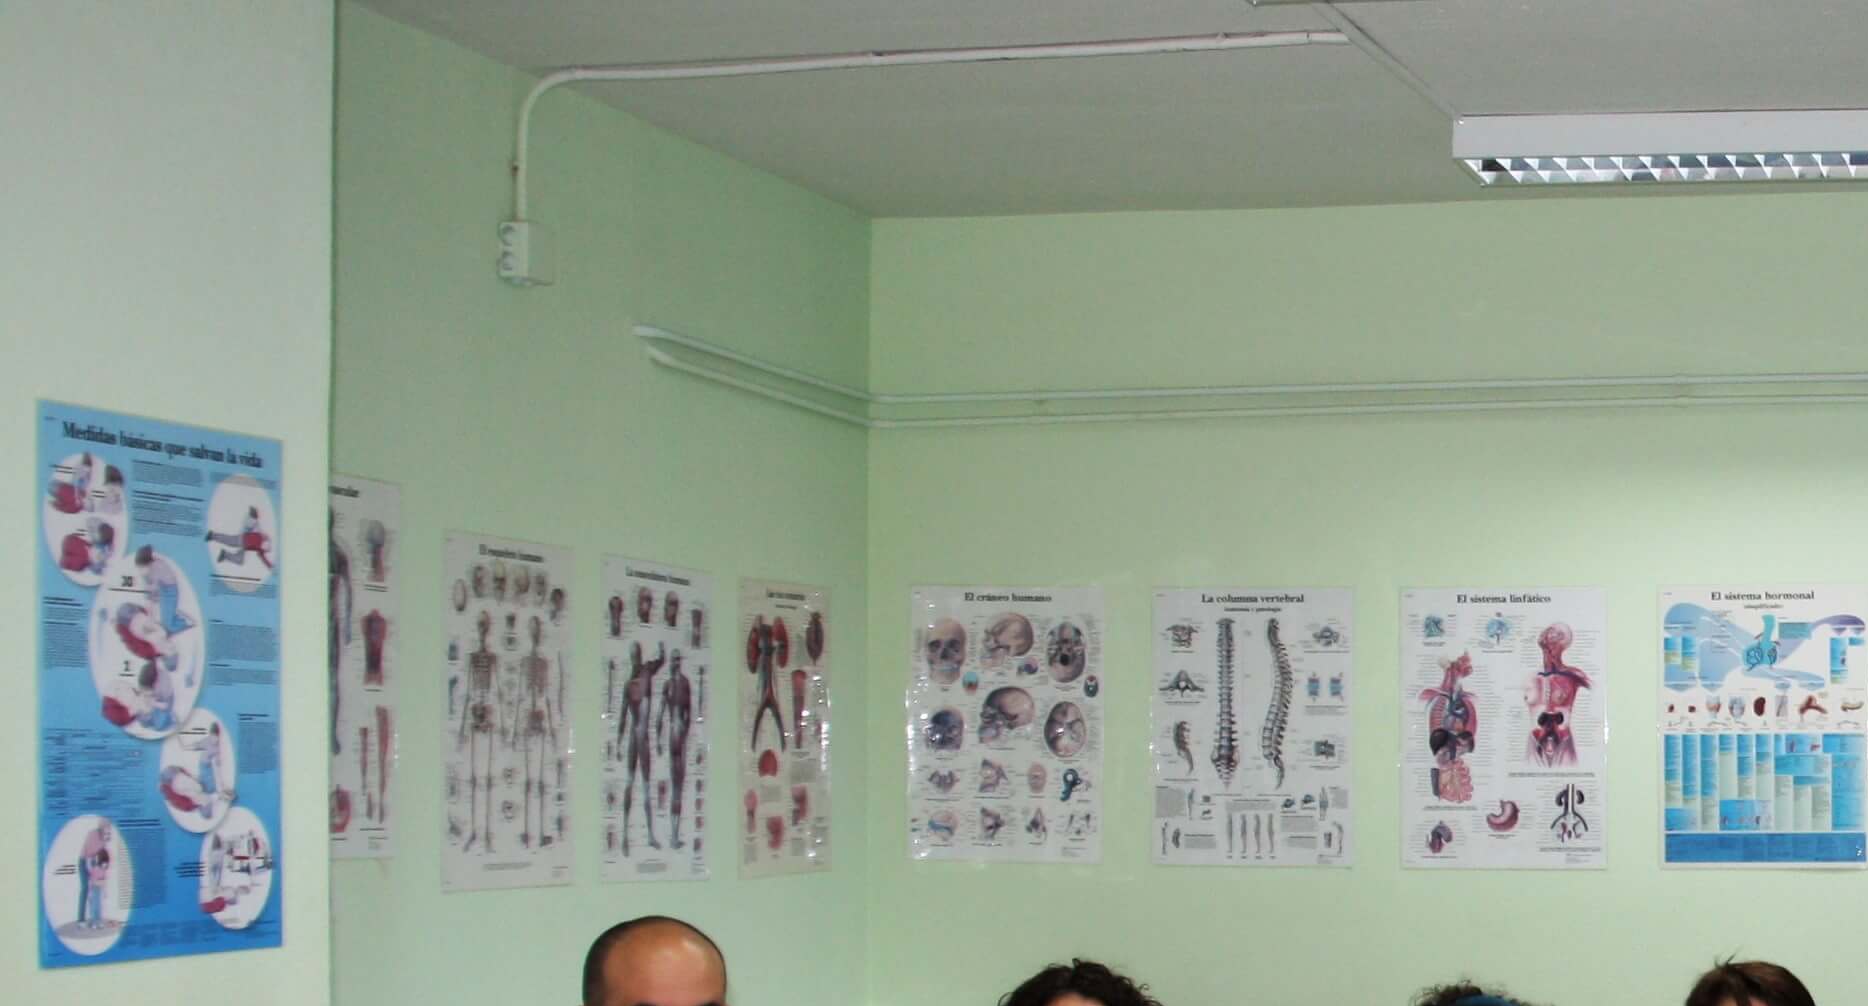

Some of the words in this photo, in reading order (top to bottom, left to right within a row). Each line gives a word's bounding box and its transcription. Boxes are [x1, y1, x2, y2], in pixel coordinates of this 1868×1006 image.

[62, 420, 117, 445] Medidas
[1201, 593, 1214, 603] La
[1216, 593, 1258, 603] columna
[1260, 593, 1304, 603] vertebral
[1457, 594, 1467, 604] El
[1711, 591, 1721, 601] El
[1724, 591, 1762, 601] sistema
[1764, 590, 1815, 600] hormonal
